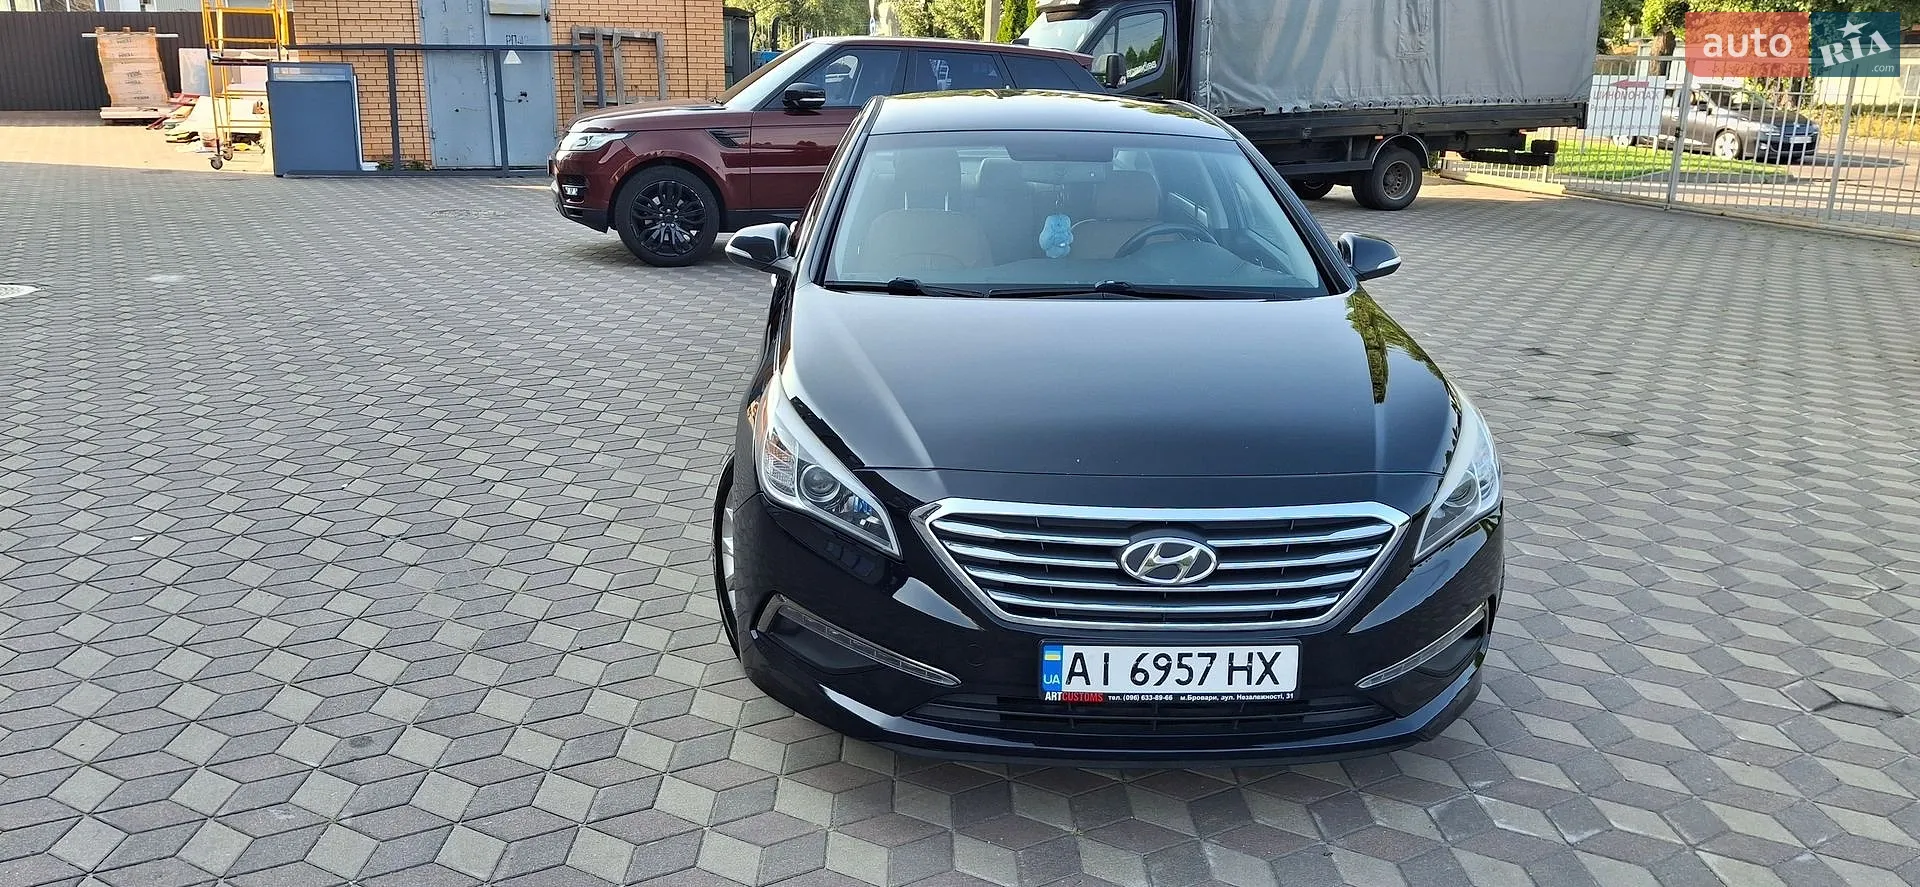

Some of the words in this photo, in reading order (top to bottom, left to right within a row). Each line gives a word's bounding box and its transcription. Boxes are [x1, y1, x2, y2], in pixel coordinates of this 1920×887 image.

[1043, 674, 1061, 685] UA
[1065, 652, 1110, 686] AI
[1130, 652, 1217, 687] 6957
[1227, 652, 1282, 686] HX
